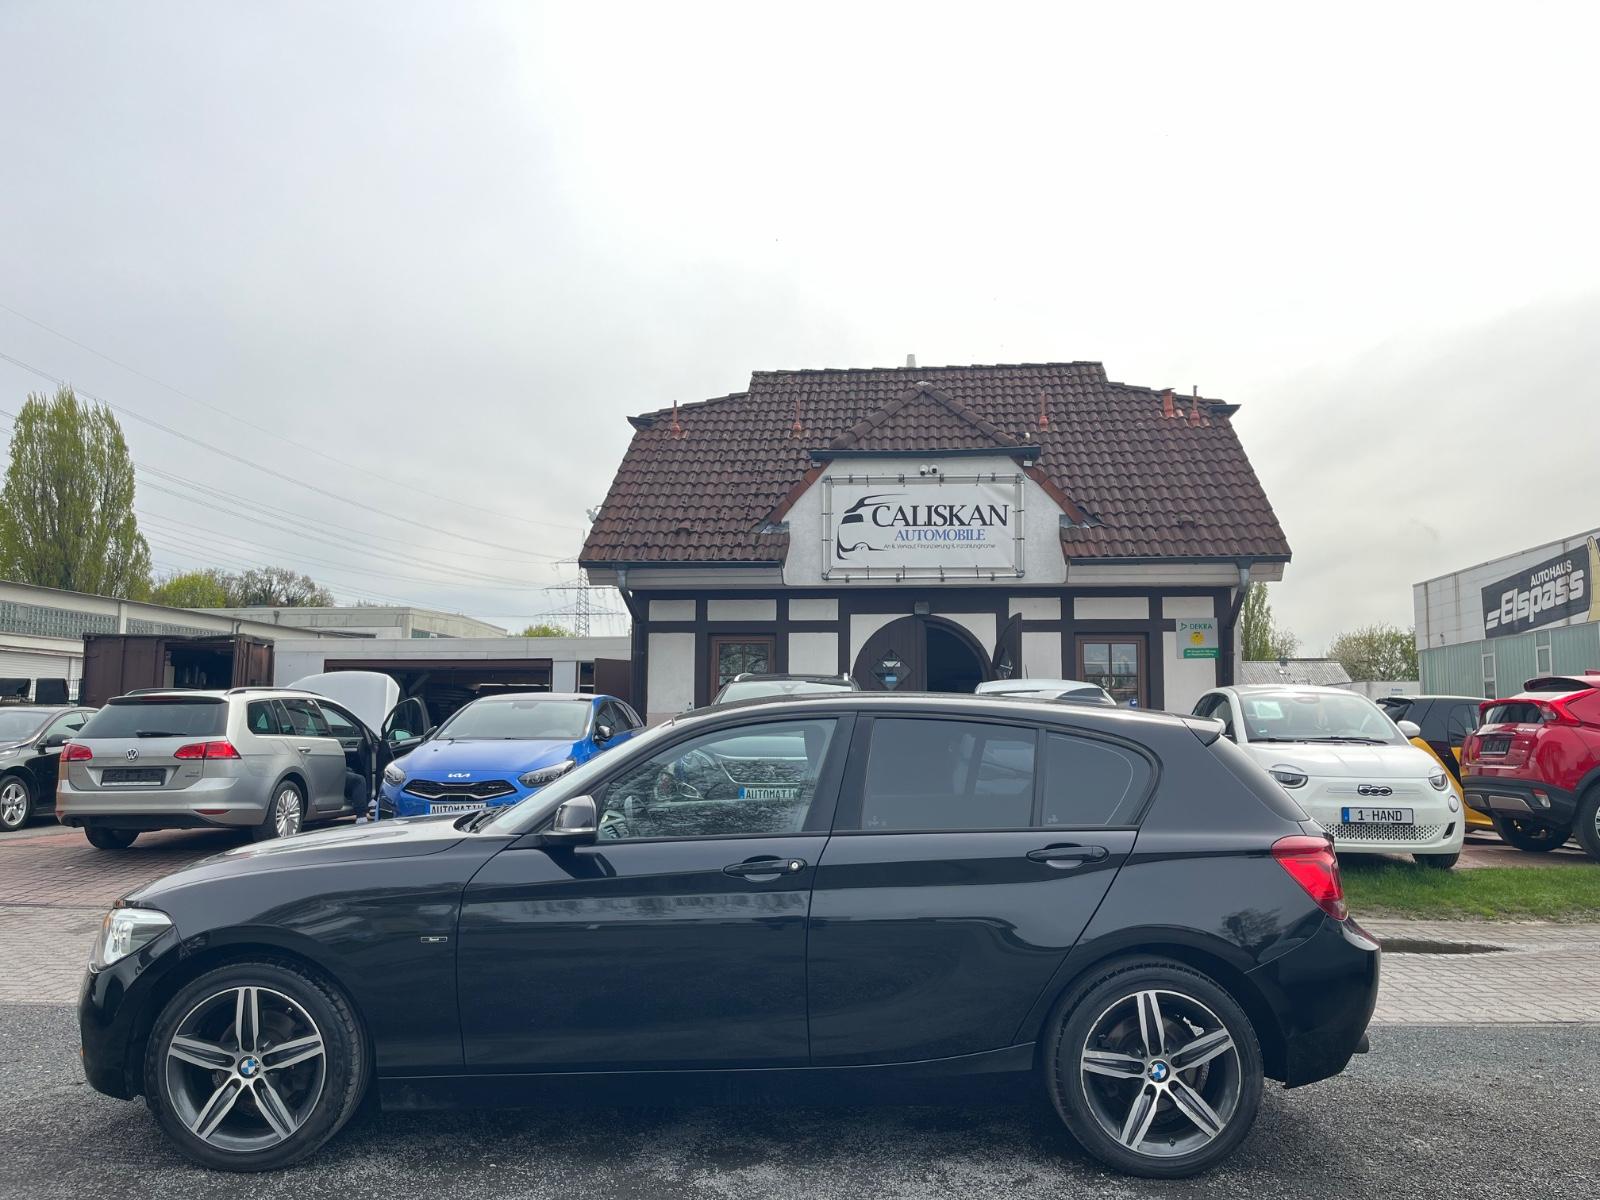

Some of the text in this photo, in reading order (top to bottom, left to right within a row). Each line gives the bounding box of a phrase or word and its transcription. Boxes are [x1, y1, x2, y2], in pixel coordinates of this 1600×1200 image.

[872, 504, 1010, 528] CALISKAN
[894, 528, 986, 542] AUTOMOBILE
[1530, 560, 1572, 587] AUTOHAUS
[1358, 784, 1393, 796] 500
